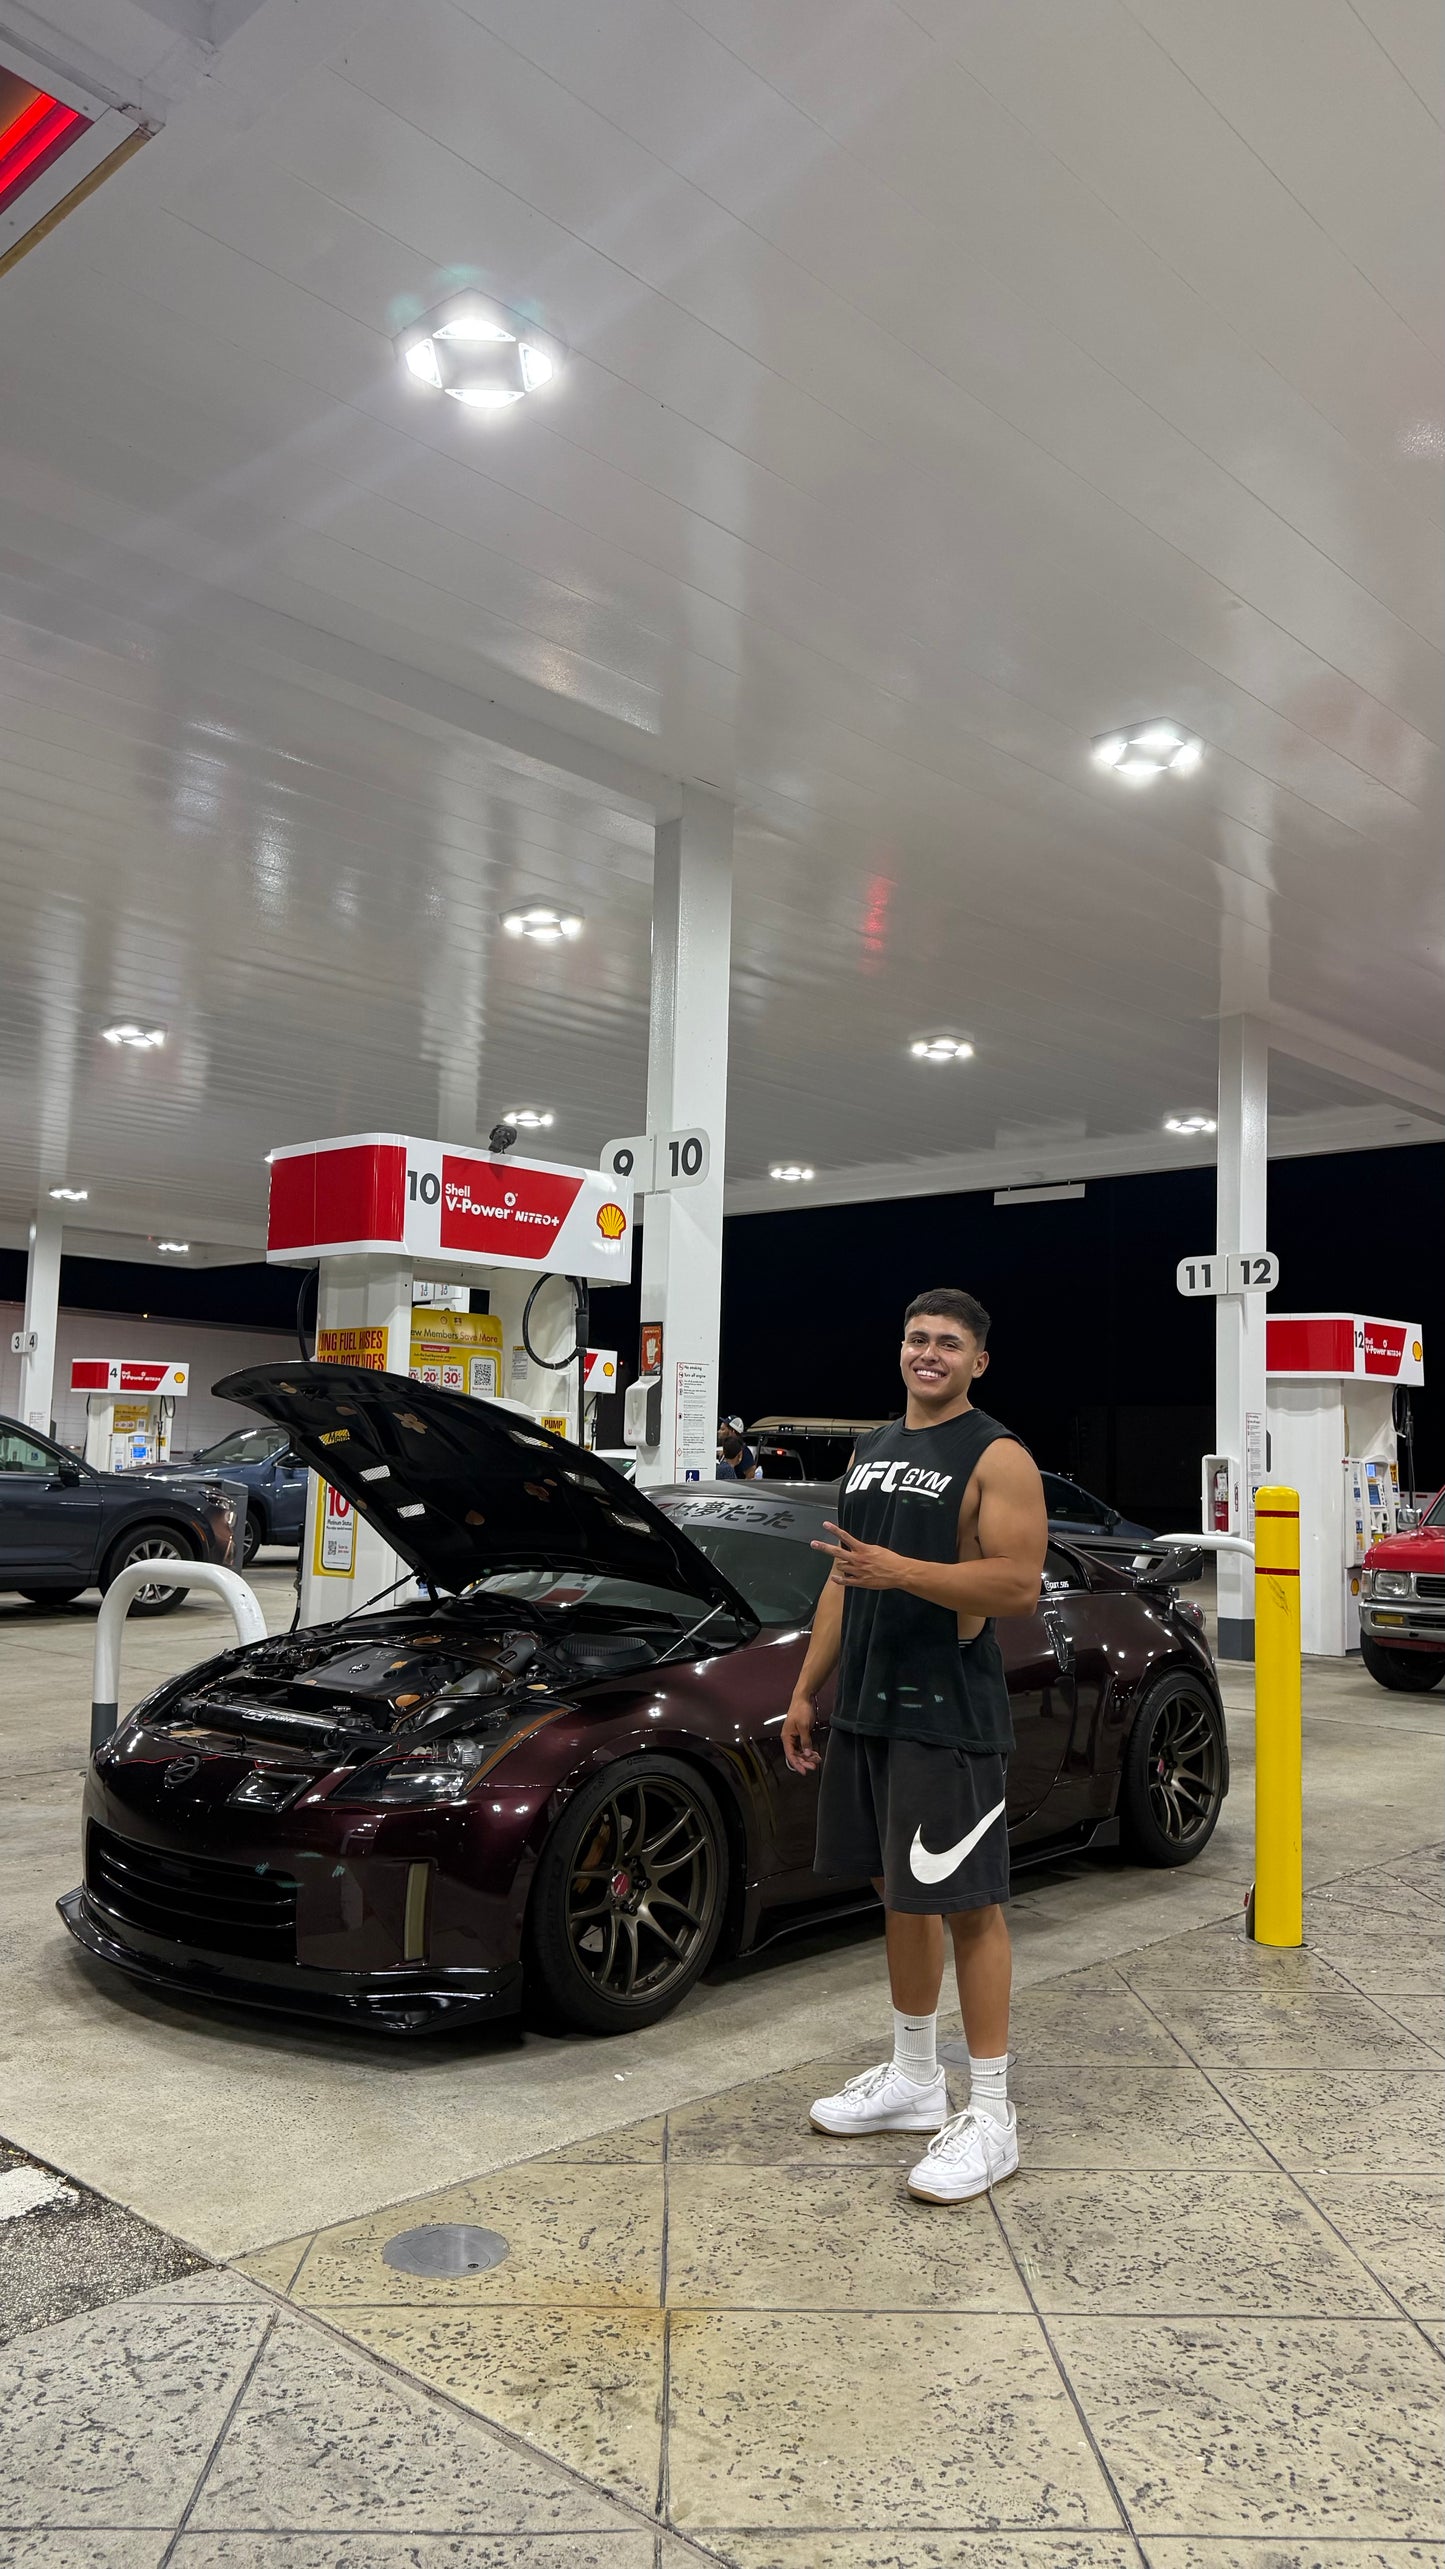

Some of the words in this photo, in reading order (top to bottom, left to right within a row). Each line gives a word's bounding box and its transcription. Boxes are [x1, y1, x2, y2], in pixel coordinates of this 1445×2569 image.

[613, 1149, 634, 1177] 9
[668, 1137, 703, 1177] 10
[407, 1170, 440, 1205] 10
[445, 1183, 470, 1197] Shell
[445, 1196, 509, 1220] V-Power
[1185, 1263, 1211, 1290] 11
[1240, 1258, 1272, 1285] 12
[14, 1336, 20, 1349] 3
[29, 1335, 35, 1348] 4
[339, 1331, 357, 1350] FUEL
[423, 1328, 458, 1340] Members
[460, 1331, 477, 1341] Save
[479, 1333, 498, 1343] More
[1354, 1331, 1364, 1349] 12
[110, 1367, 118, 1378] 4
[544, 1419, 563, 1430] PUMP
[845, 1461, 910, 1495] UFC
[901, 1468, 953, 1493] GYM
